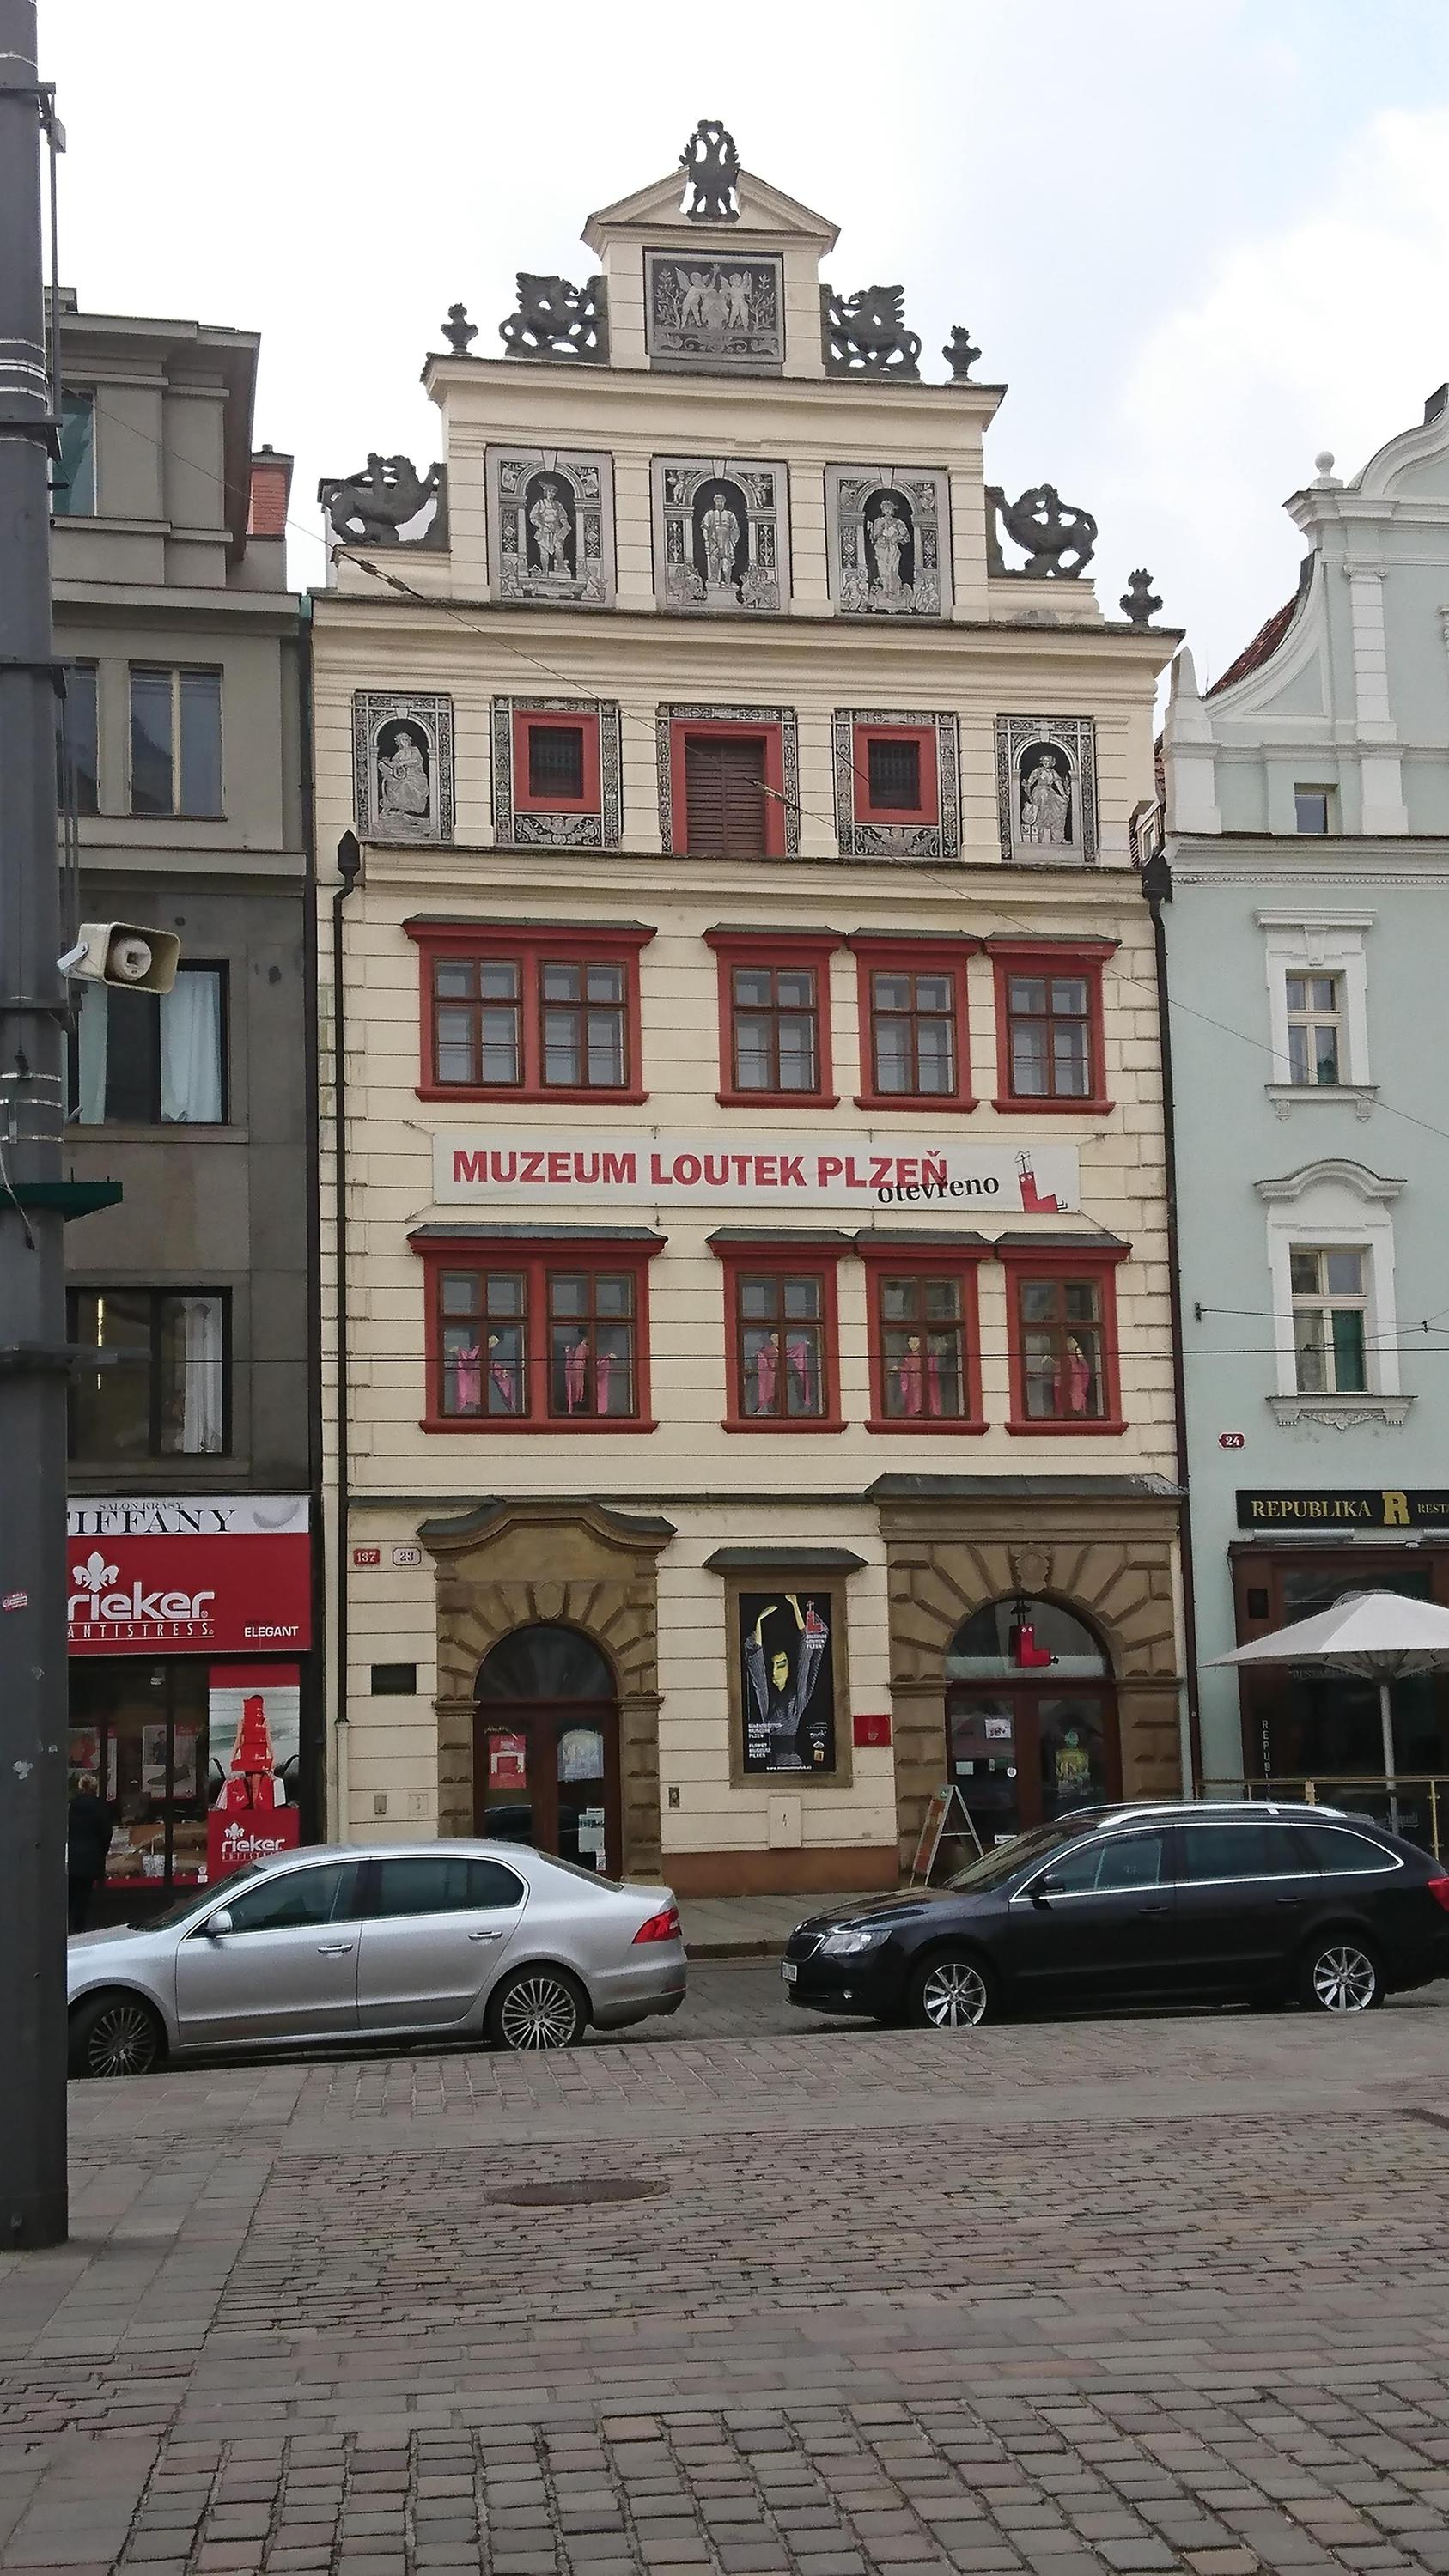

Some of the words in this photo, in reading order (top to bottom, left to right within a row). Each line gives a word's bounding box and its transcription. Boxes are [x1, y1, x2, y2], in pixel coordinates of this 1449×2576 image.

[453, 1151, 637, 1184] MUZEUM
[650, 1153, 805, 1187] LOUTEK
[817, 1150, 949, 1190] PLZEŇ
[877, 1174, 1001, 1204] otevřeno
[1225, 1435, 1241, 1447] 24
[98, 1502, 138, 1510] SALON
[1251, 1499, 1373, 1518] REPUBLIKA
[1381, 1492, 1411, 1525] R
[67, 1509, 238, 1535] IFFANY
[356, 1552, 377, 1563] 137
[399, 1552, 414, 1562] 23
[67, 1581, 215, 1621] rieker
[67, 1623, 210, 1639] ANTISTRESS
[244, 1625, 300, 1637] ELEGANT
[221, 1834, 287, 1853] rieker
